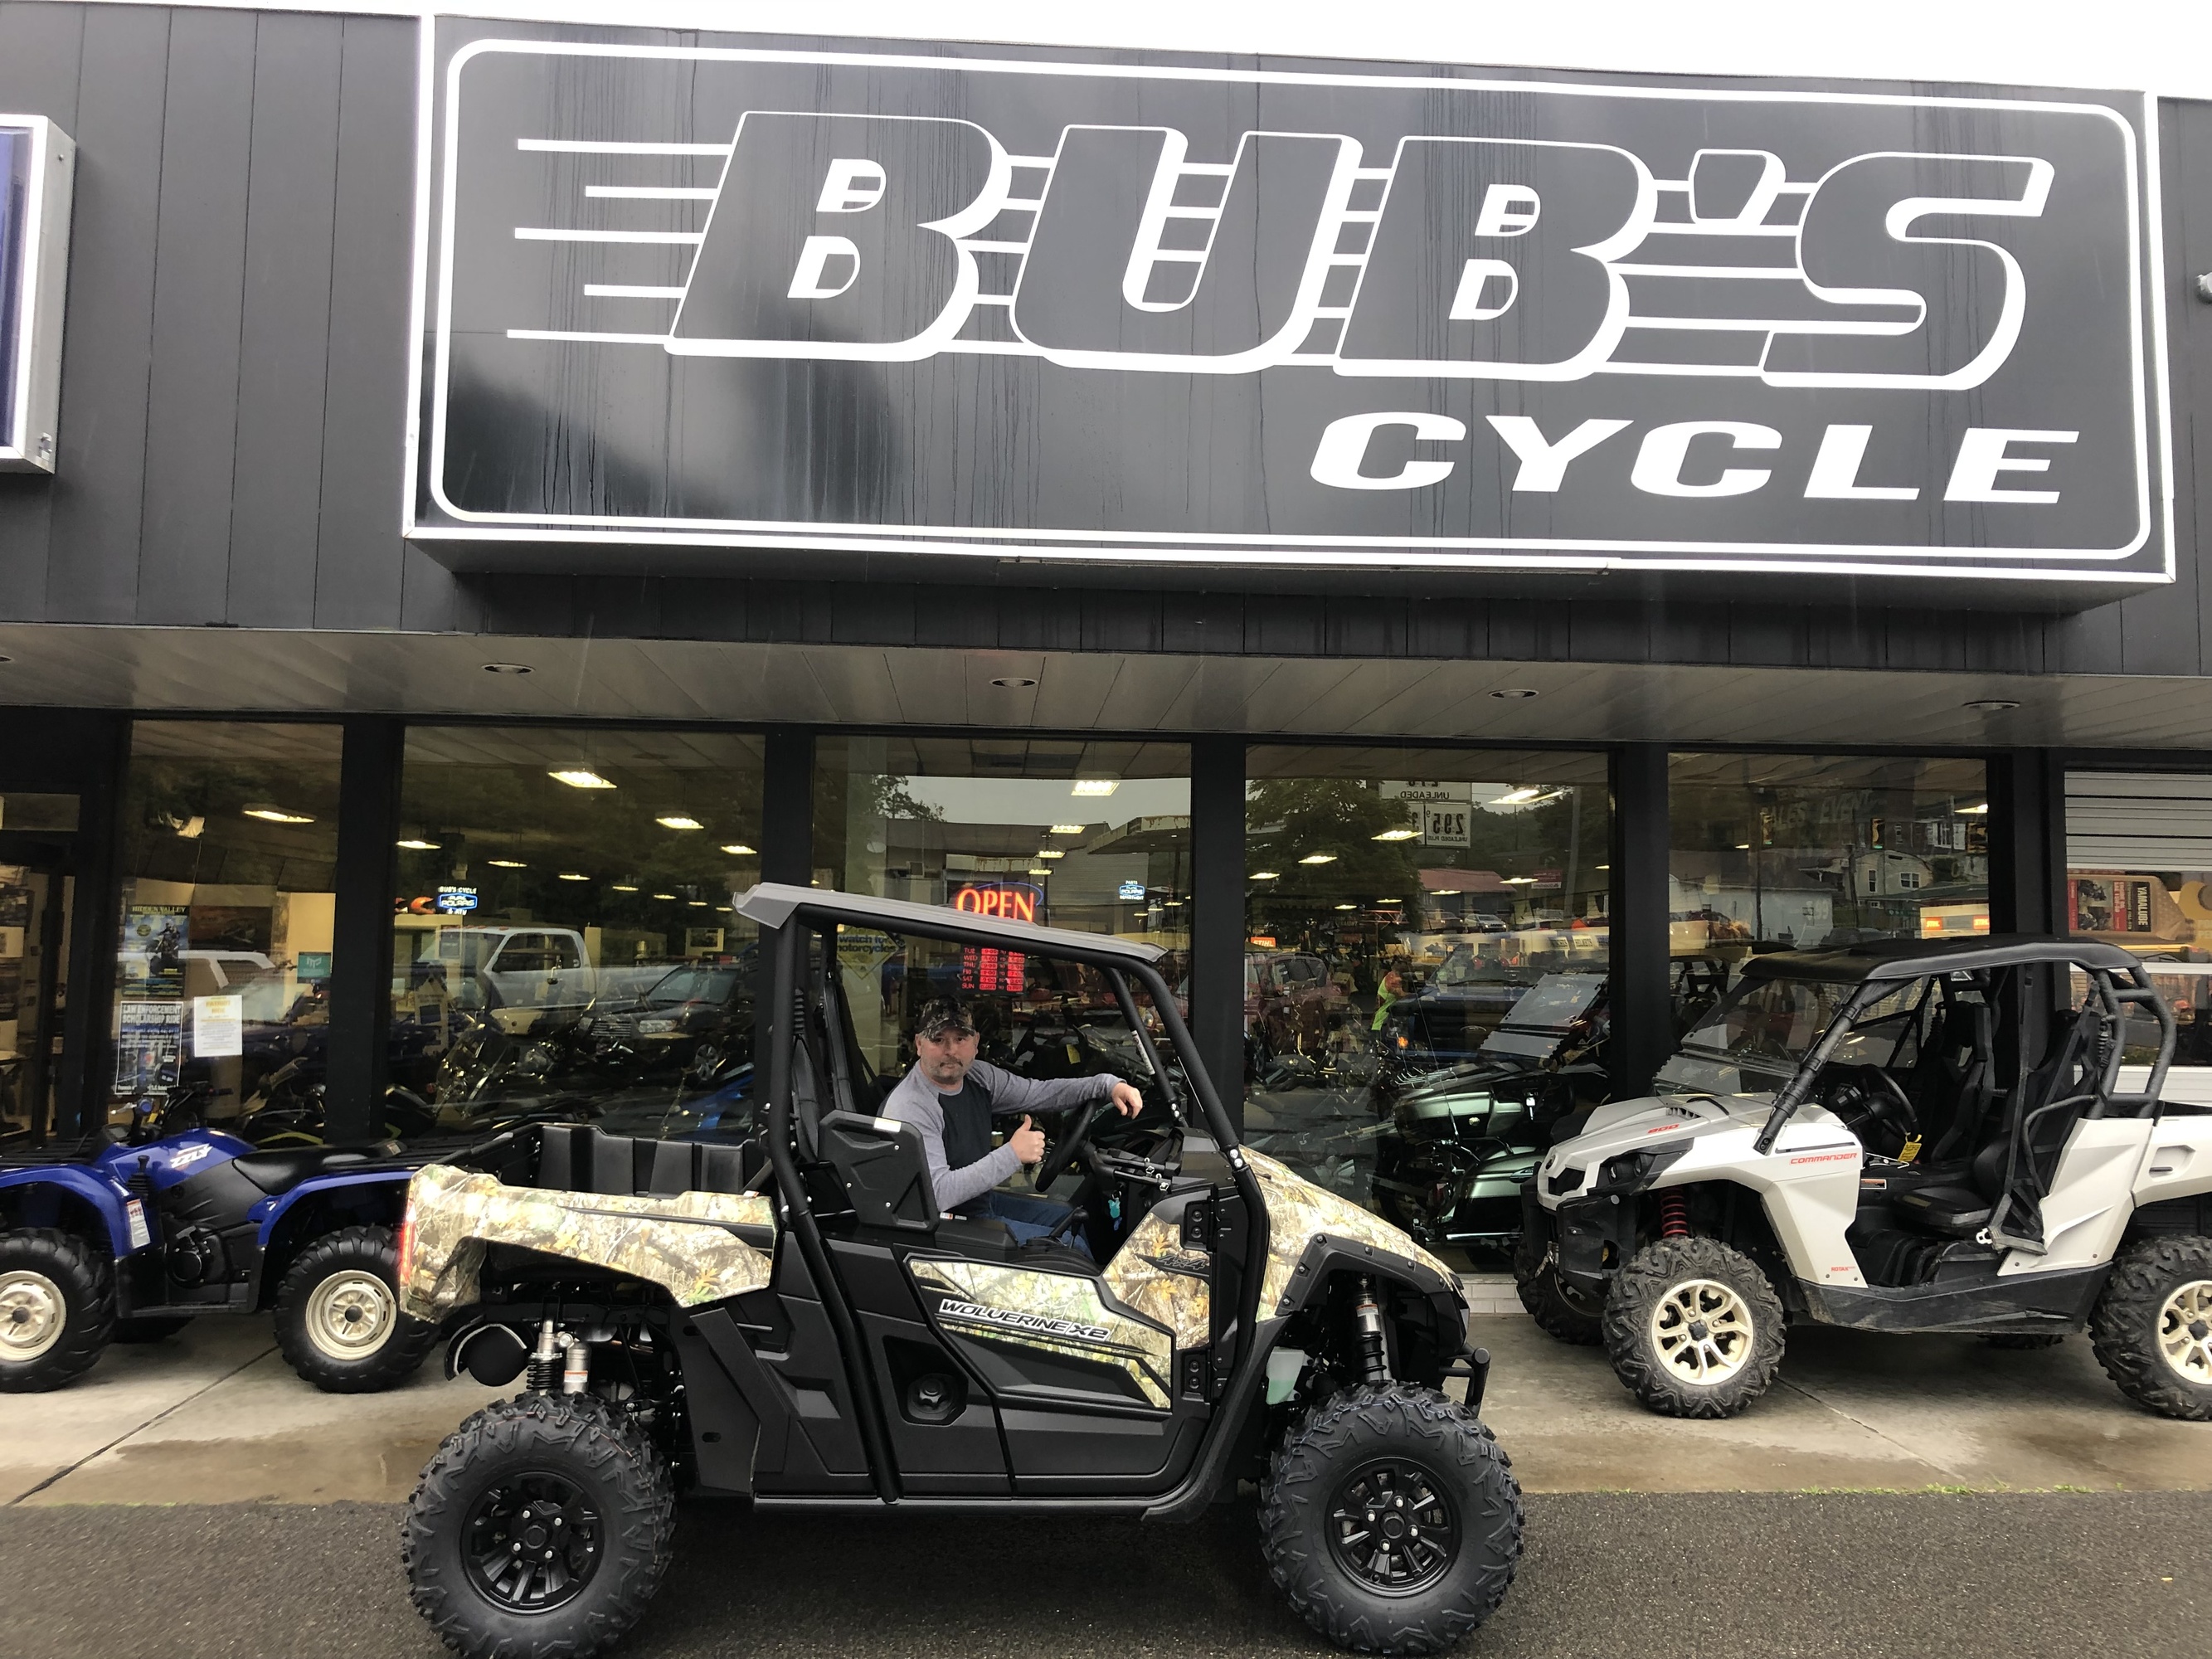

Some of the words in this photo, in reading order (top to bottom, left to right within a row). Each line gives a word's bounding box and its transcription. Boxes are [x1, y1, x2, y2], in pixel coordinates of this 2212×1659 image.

[663, 111, 2054, 390] BUB'S
[1310, 411, 2079, 504] CYCLE
[956, 888, 1035, 922] OPEN
[2137, 886, 2149, 926] YAMALUBE
[838, 935, 872, 943] watch
[122, 1014, 164, 1024] SCHOLARSHIP
[165, 1014, 181, 1024] RIDE
[123, 1005, 137, 1014] LAW
[137, 1005, 181, 1014] ENFORCEMENT
[1790, 1152, 1858, 1165] COMMANDER
[939, 1298, 1071, 1336] WOLVERINE
